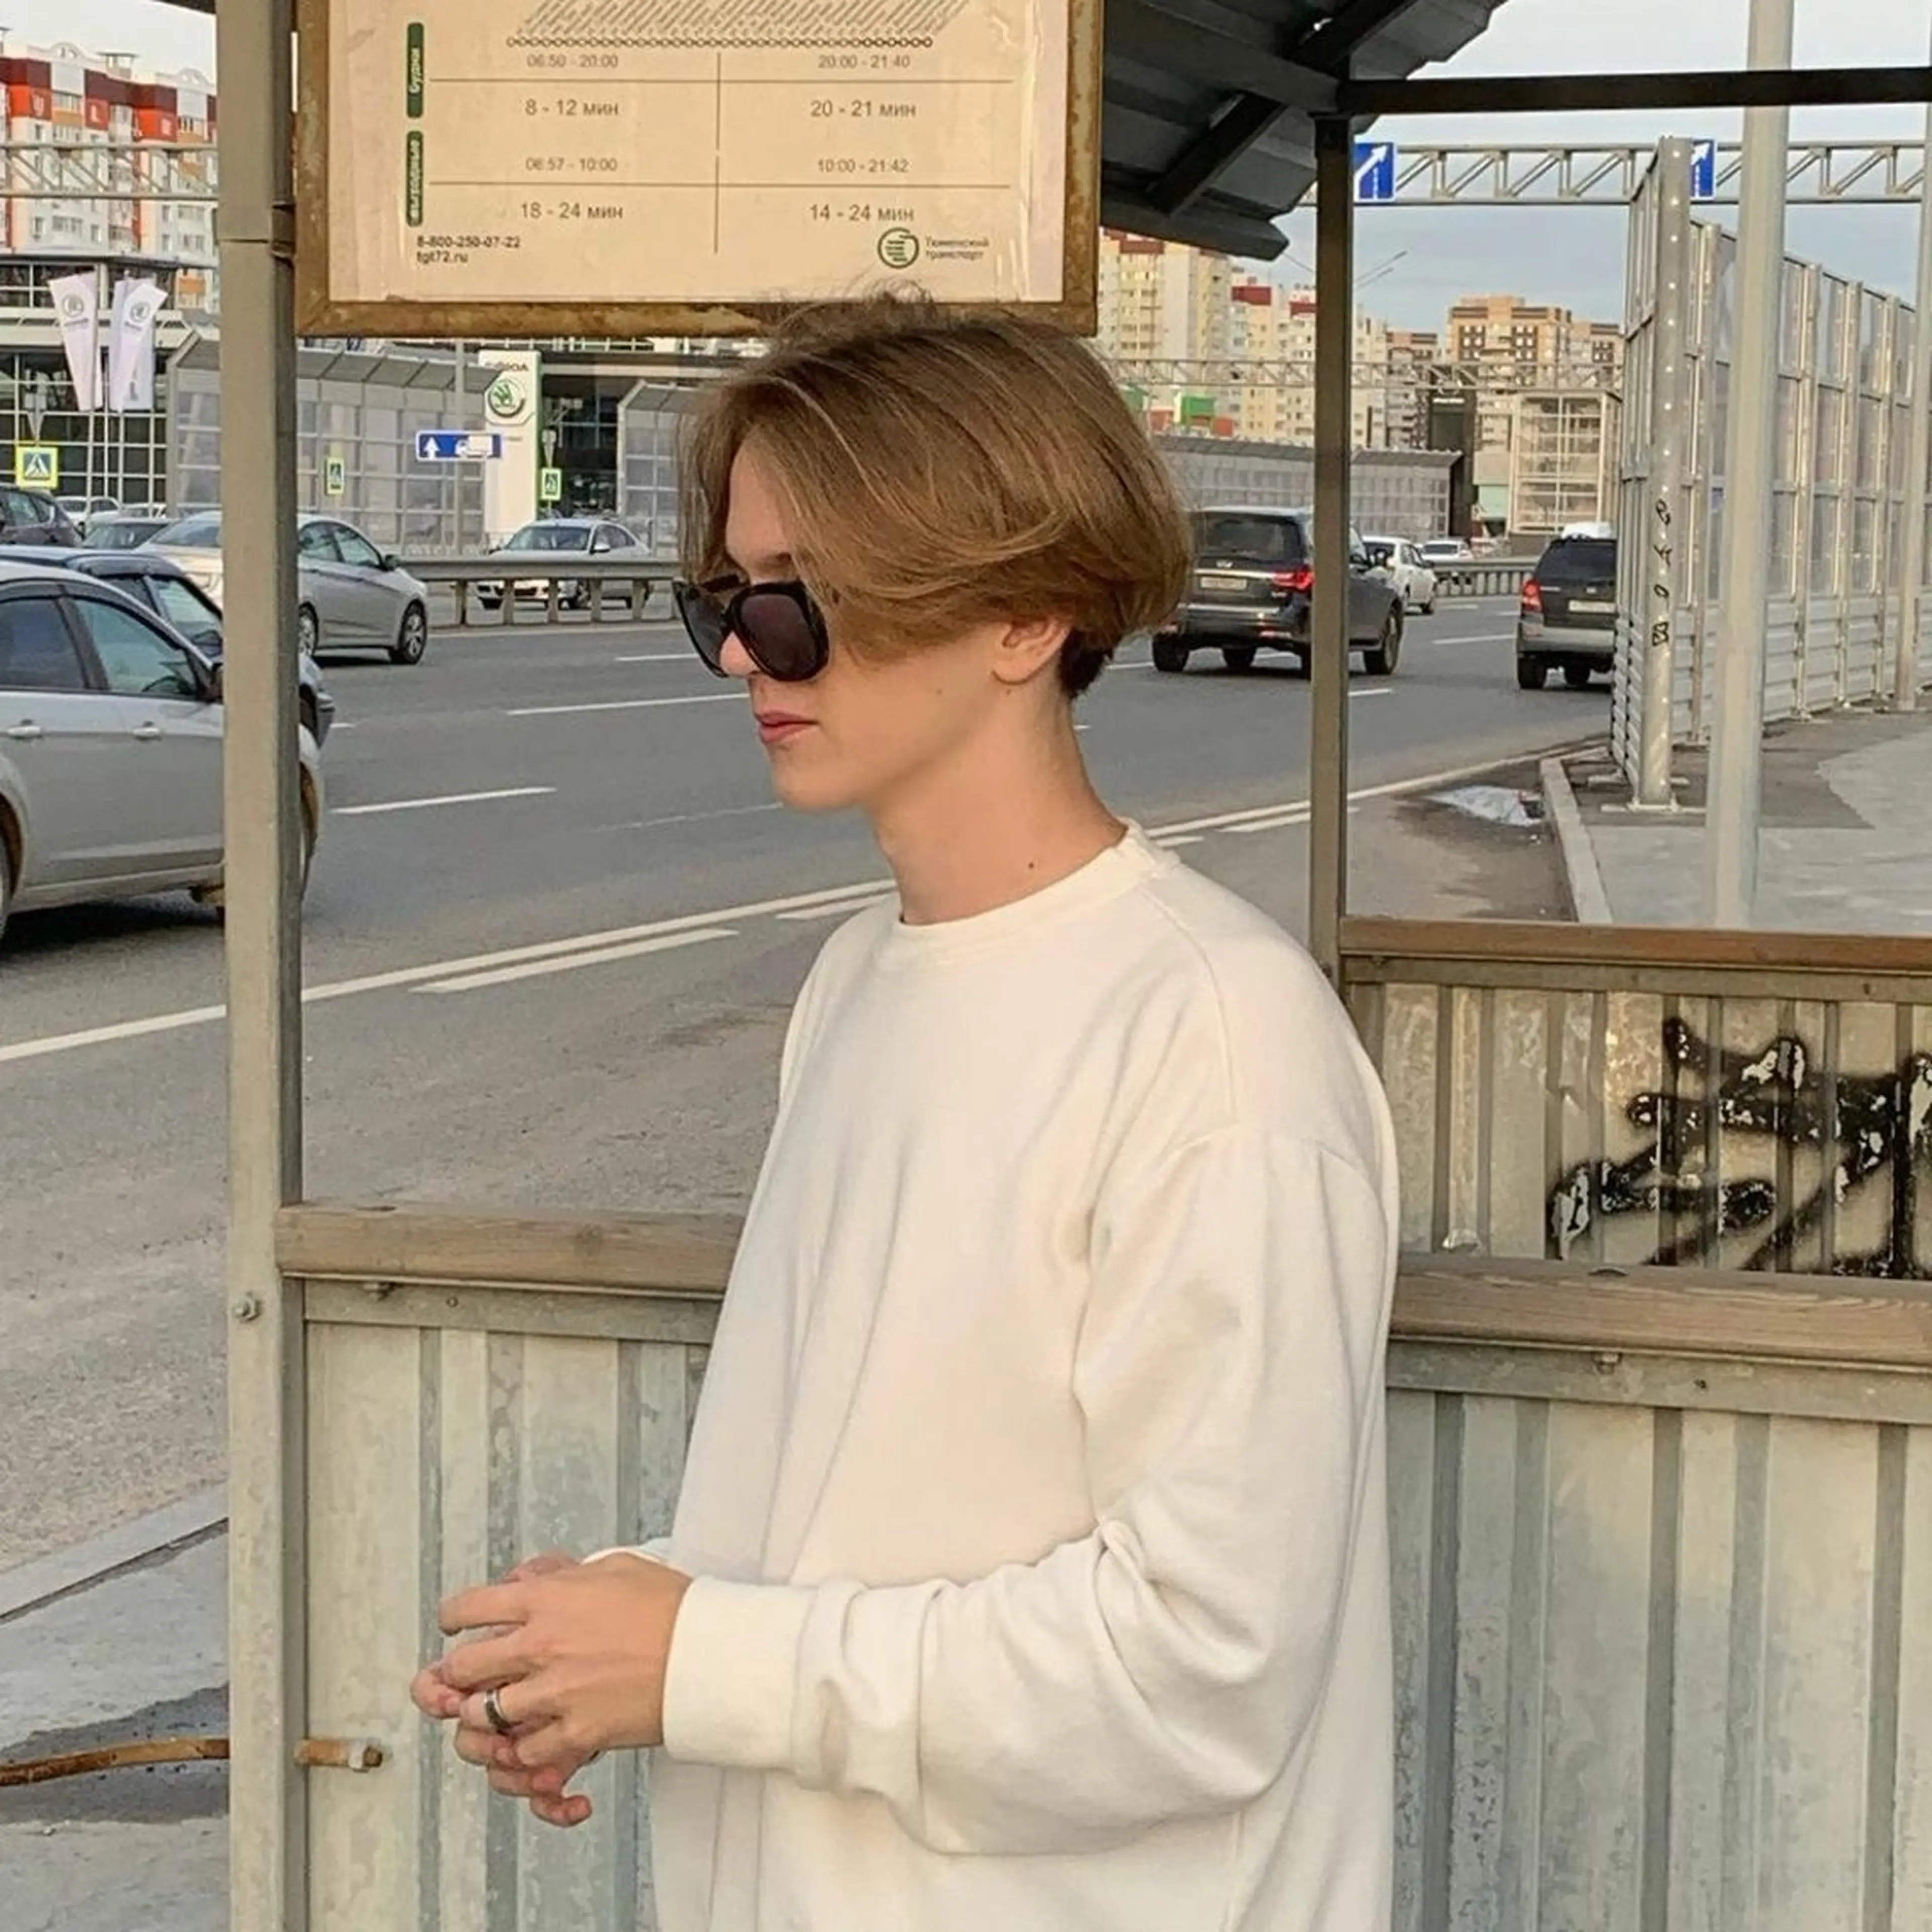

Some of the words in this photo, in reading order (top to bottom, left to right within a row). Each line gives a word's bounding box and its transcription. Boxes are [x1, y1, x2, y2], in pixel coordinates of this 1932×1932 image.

[580, 54, 618, 68] 20:00
[818, 54, 857, 69] 20:00
[870, 54, 911, 69] 21:40
[525, 99, 537, 116] 8
[557, 99, 578, 116] 12
[583, 102, 618, 116] мин
[811, 100, 833, 118] 20
[851, 100, 872, 117] 21
[879, 103, 916, 118] мин
[579, 157, 618, 172] 10:00
[818, 158, 856, 173] 10:00
[869, 158, 910, 173] 21:42
[522, 201, 542, 218] 18
[559, 201, 581, 219] 24
[587, 206, 623, 219] мин
[811, 203, 830, 221] 14
[849, 203, 871, 221] 24
[878, 208, 915, 221] мин
